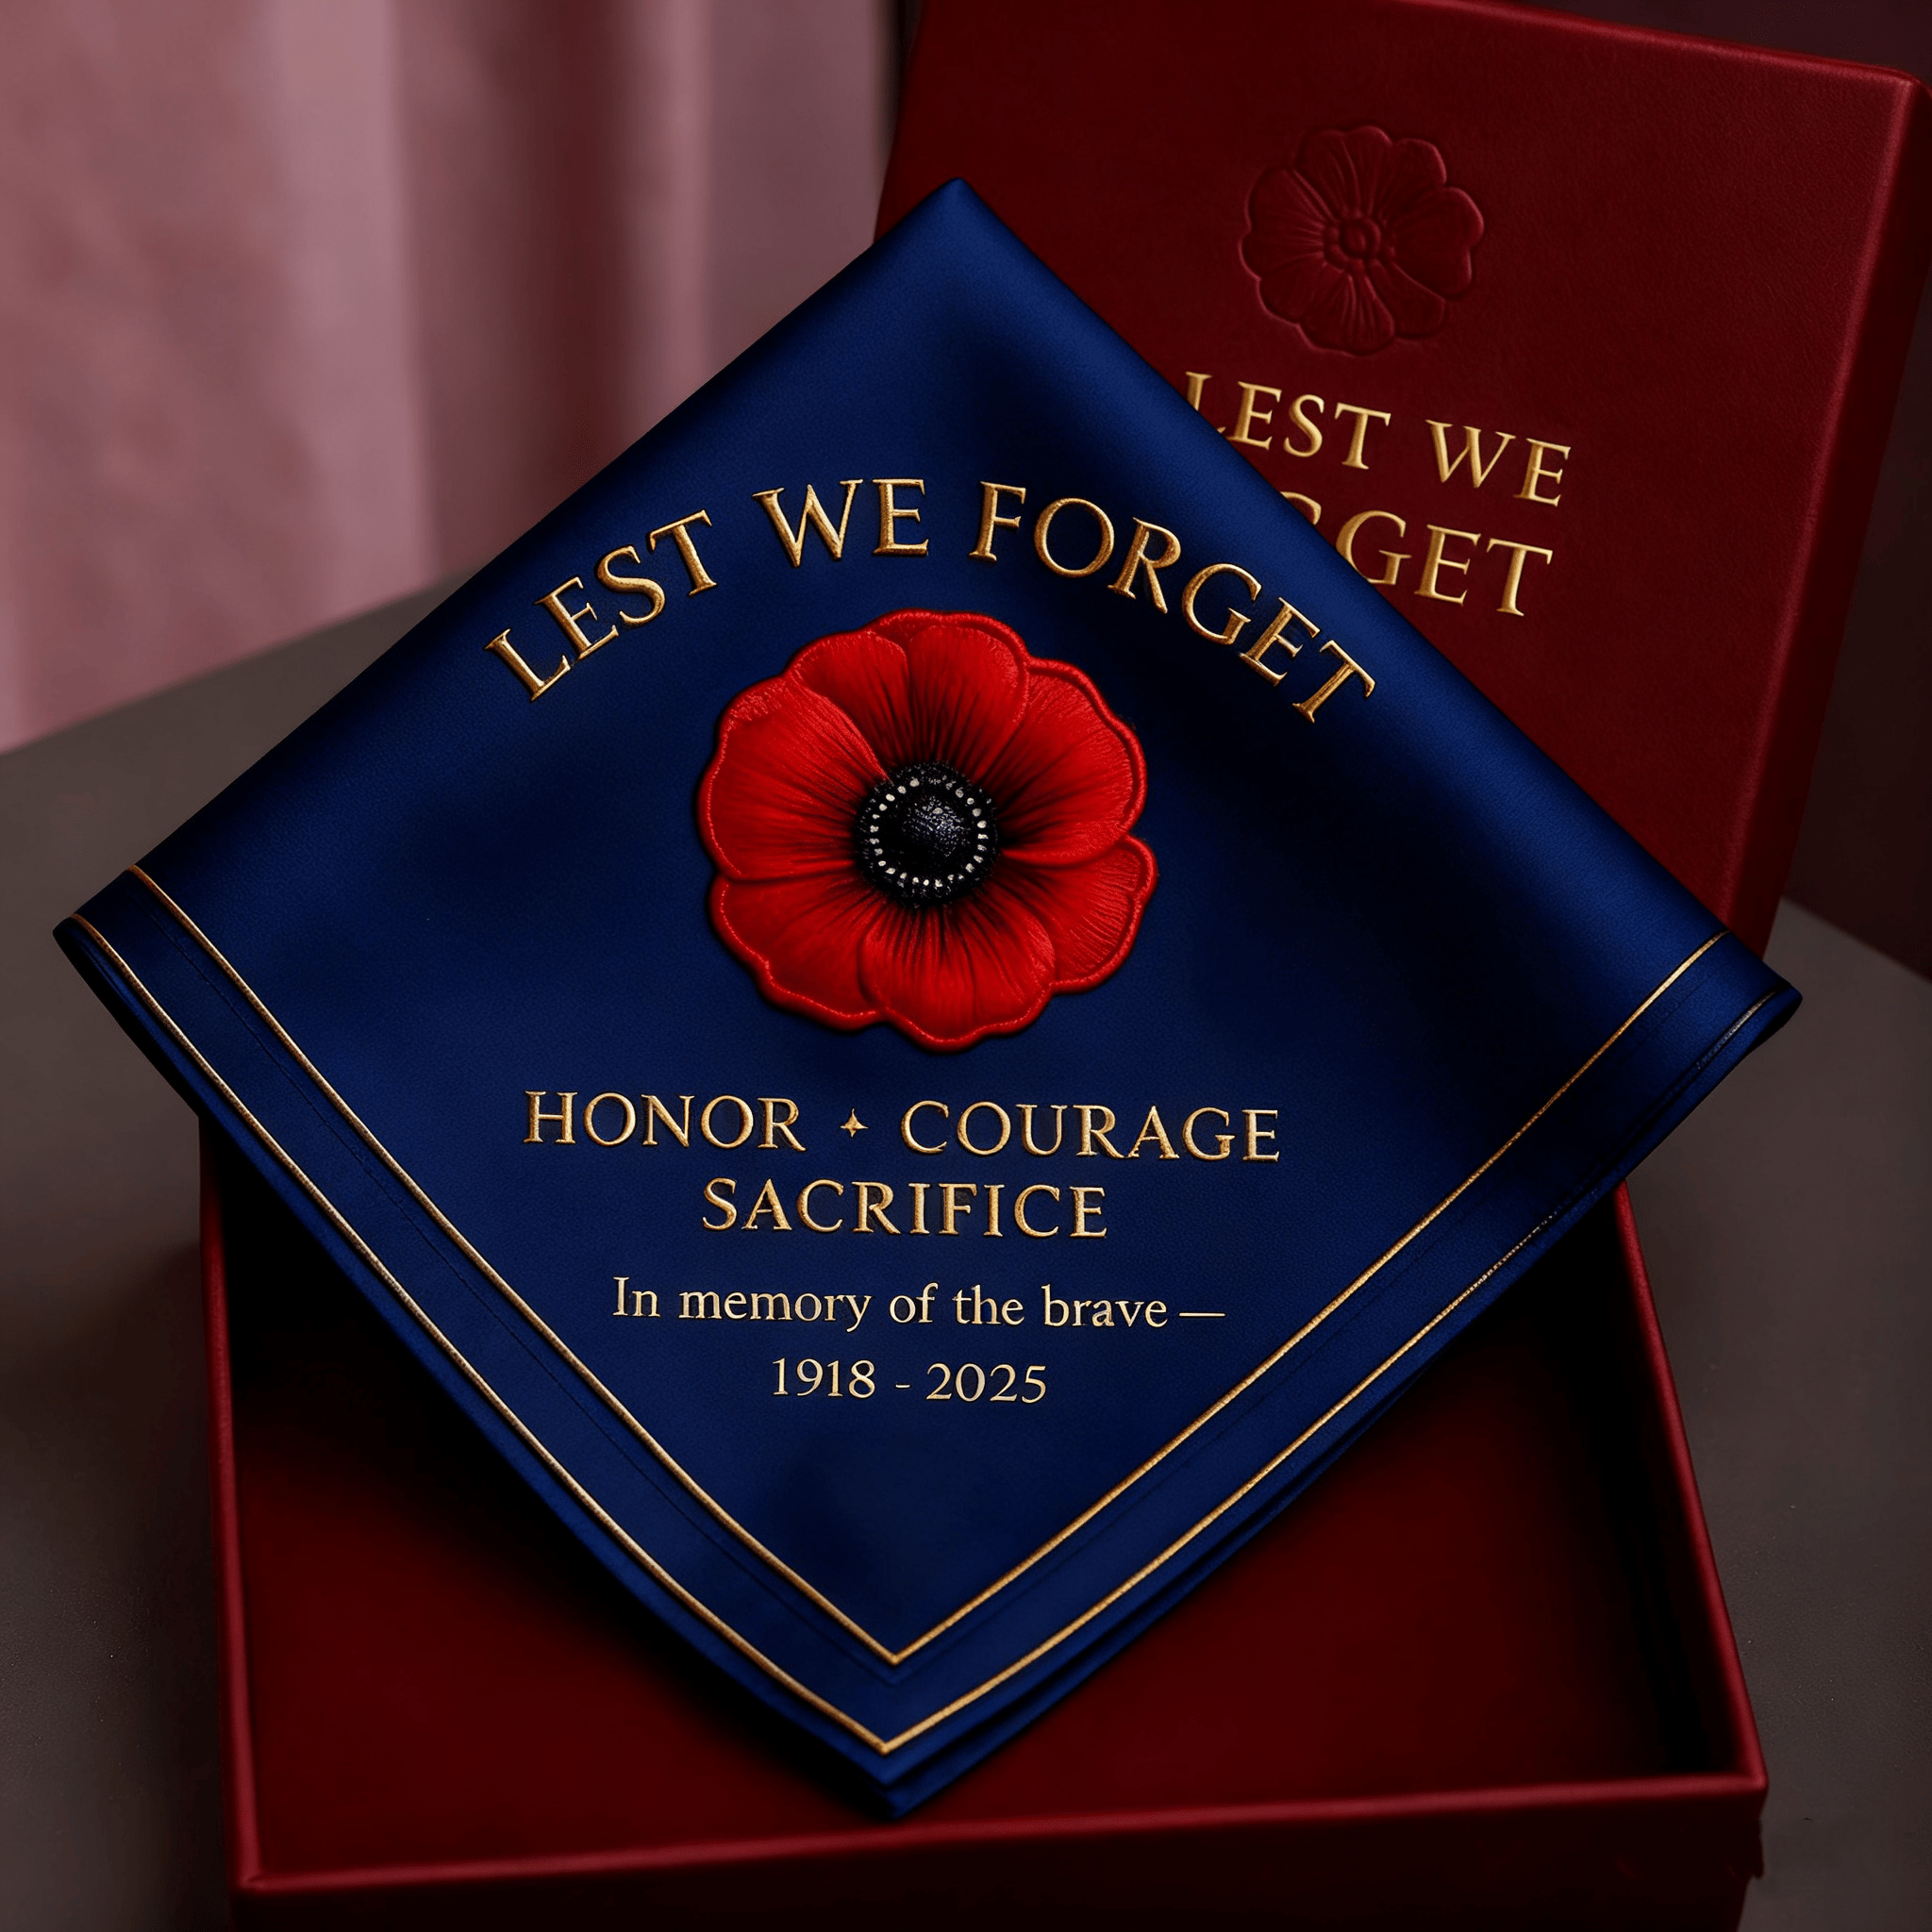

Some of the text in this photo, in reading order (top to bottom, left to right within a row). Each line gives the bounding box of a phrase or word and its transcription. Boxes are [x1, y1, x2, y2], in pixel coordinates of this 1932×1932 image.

[1425, 419, 1572, 508] WE
[1280, 491, 1554, 617] GET
[485, 478, 1376, 724] LEST WE FORGET
[524, 1091, 1281, 1162] HONOR COURAGE
[702, 1177, 1108, 1238] SACRIFICE
[612, 1276, 661, 1319] In
[678, 1291, 873, 1333] memory
[889, 1282, 940, 1324] of
[952, 1284, 1025, 1326] the
[772, 1357, 876, 1399] 1918
[925, 1362, 1047, 1405] 2025
